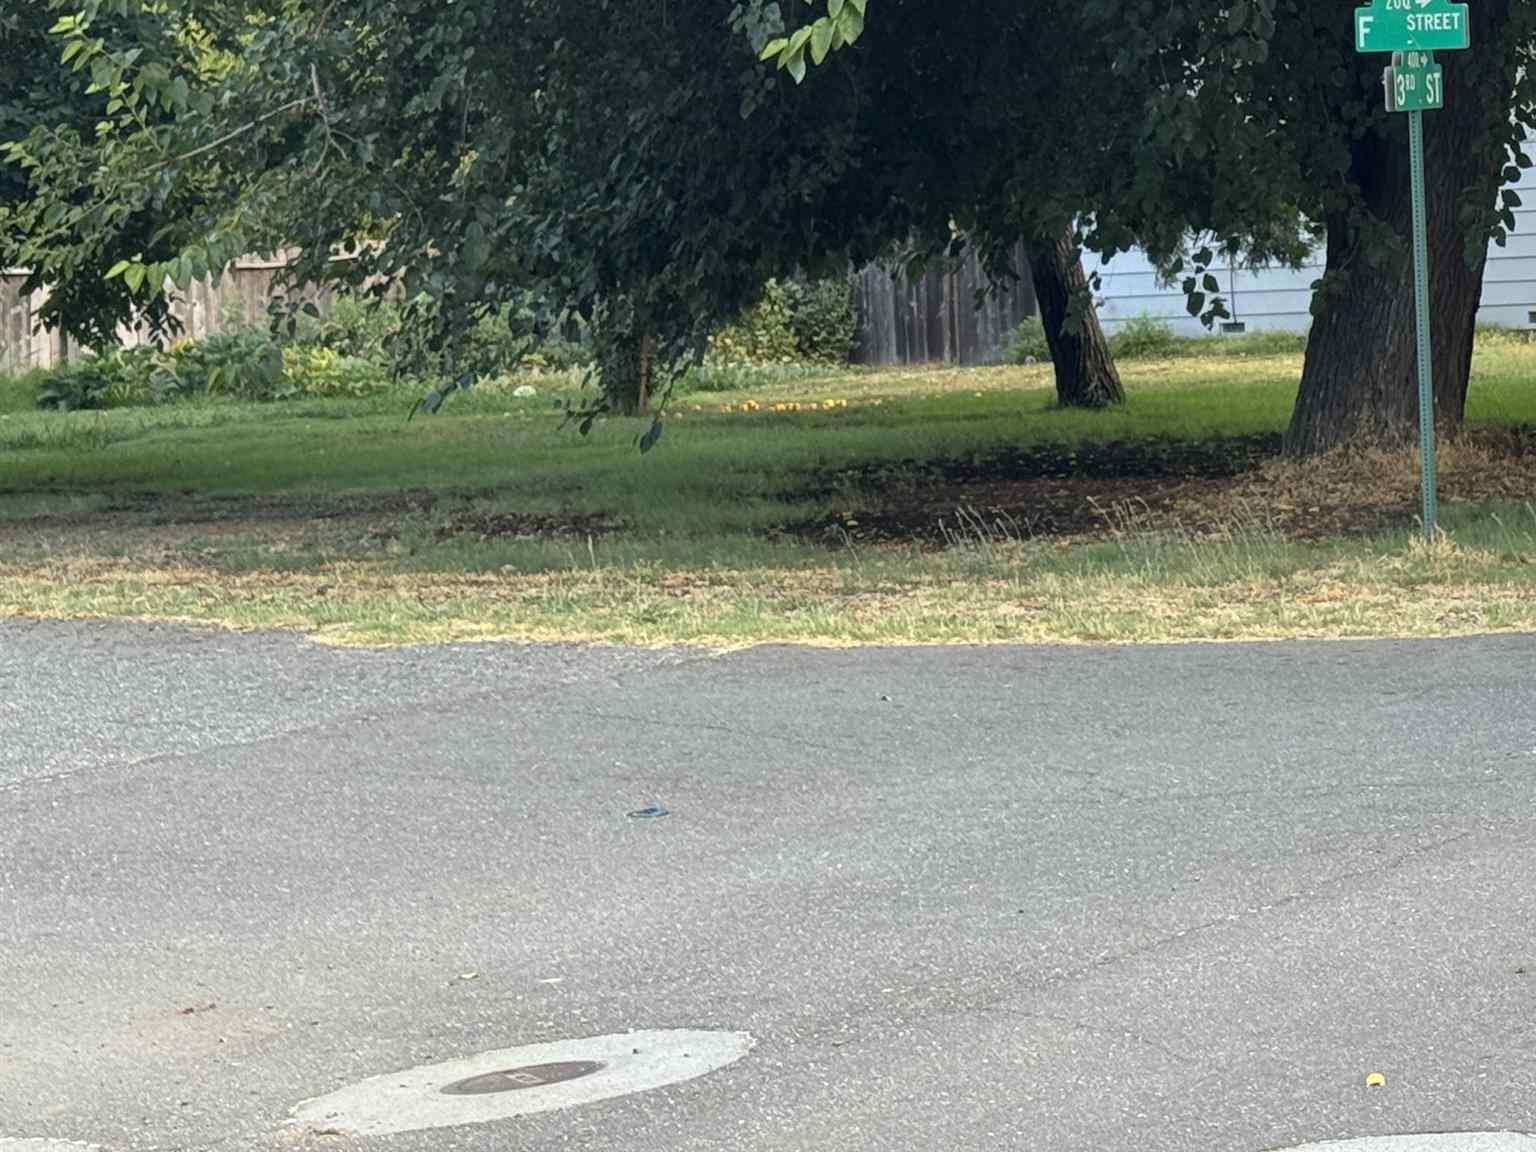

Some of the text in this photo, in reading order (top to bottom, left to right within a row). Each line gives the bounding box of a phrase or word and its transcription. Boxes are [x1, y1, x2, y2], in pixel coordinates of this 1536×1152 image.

[1359, 12, 1460, 48] F STREET
[1397, 72, 1442, 106] 3RD ST
